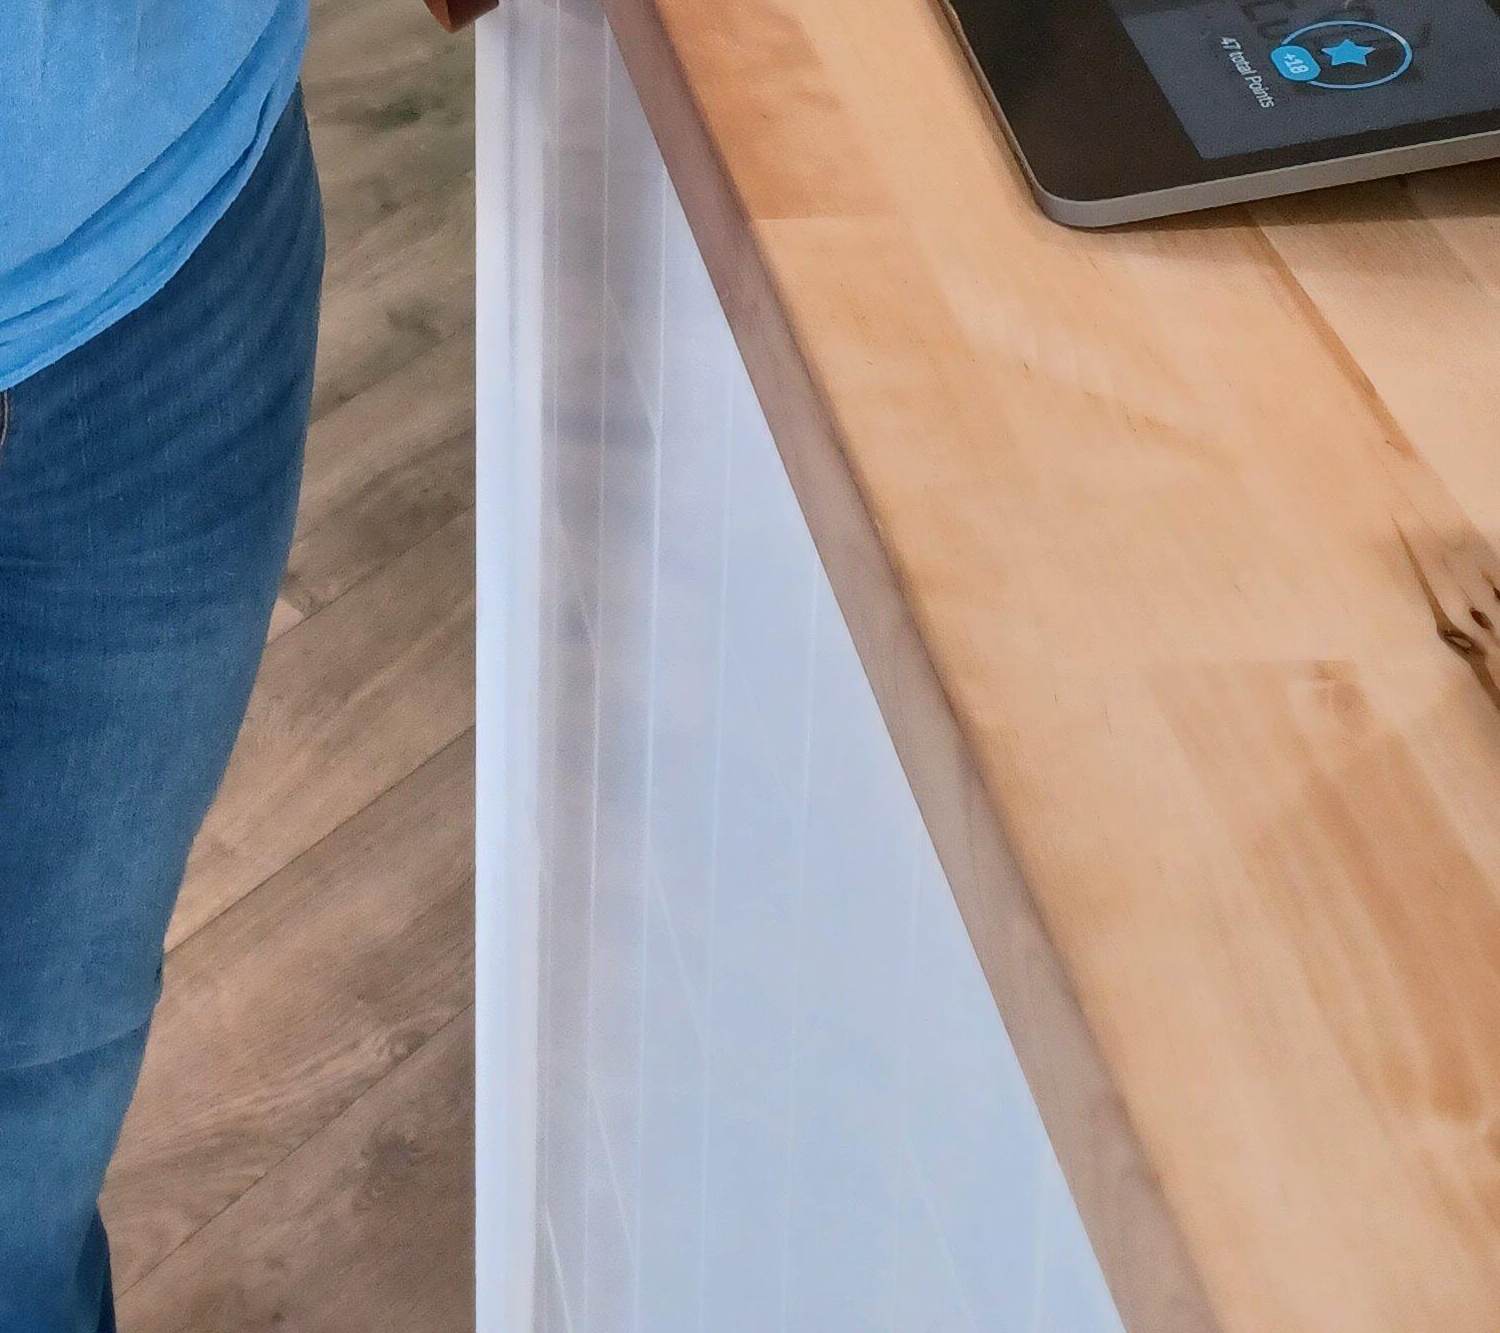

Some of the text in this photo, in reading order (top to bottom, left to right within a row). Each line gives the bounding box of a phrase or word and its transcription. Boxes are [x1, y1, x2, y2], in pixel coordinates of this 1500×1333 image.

[1220, 36, 1275, 108] 47 total Points
[1284, 52, 1310, 74] +18
